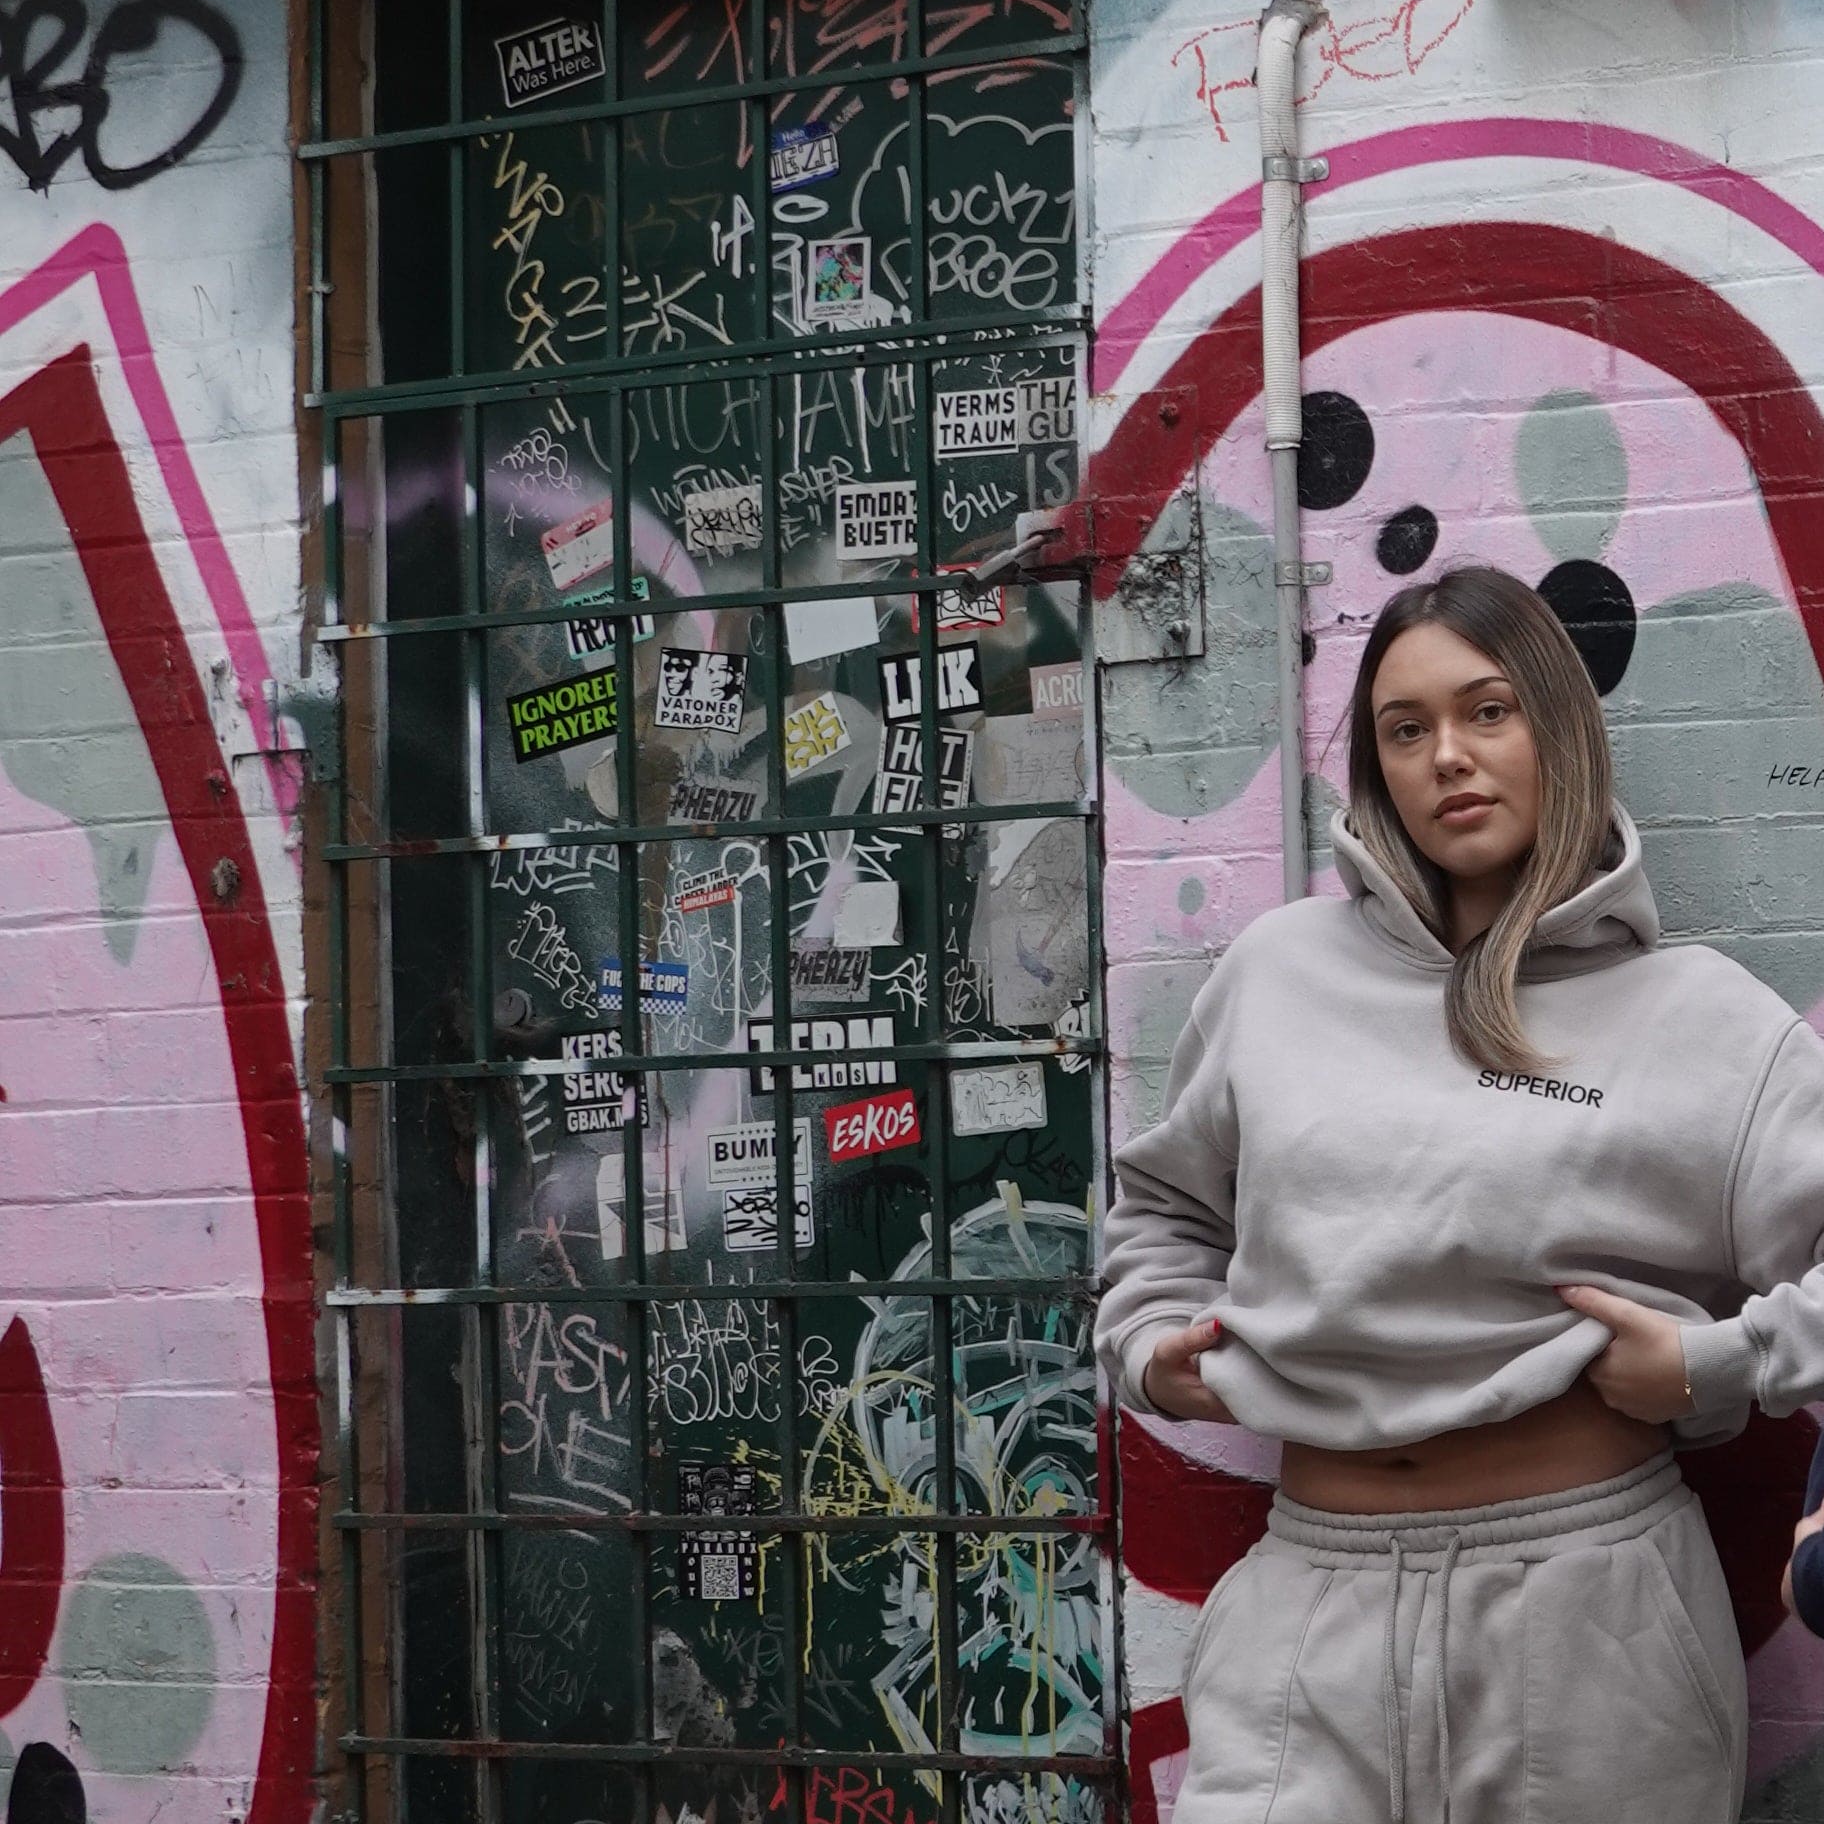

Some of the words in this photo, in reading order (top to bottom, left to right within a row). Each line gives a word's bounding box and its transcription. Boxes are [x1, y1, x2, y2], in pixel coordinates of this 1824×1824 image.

[508, 25, 595, 77] ALTER
[512, 72, 549, 94] Was
[551, 54, 596, 81] Here.
[939, 390, 1016, 419] VERMS
[939, 418, 1016, 446] TRAUM
[882, 647, 980, 719] LIK
[660, 711, 736, 728] PARADOX
[661, 696, 738, 714] VATONER
[602, 968, 623, 988] FUC
[656, 974, 687, 994] COPS
[1477, 1069, 1604, 1109] SUPERIOR
[831, 1101, 916, 1154] ESKOS
